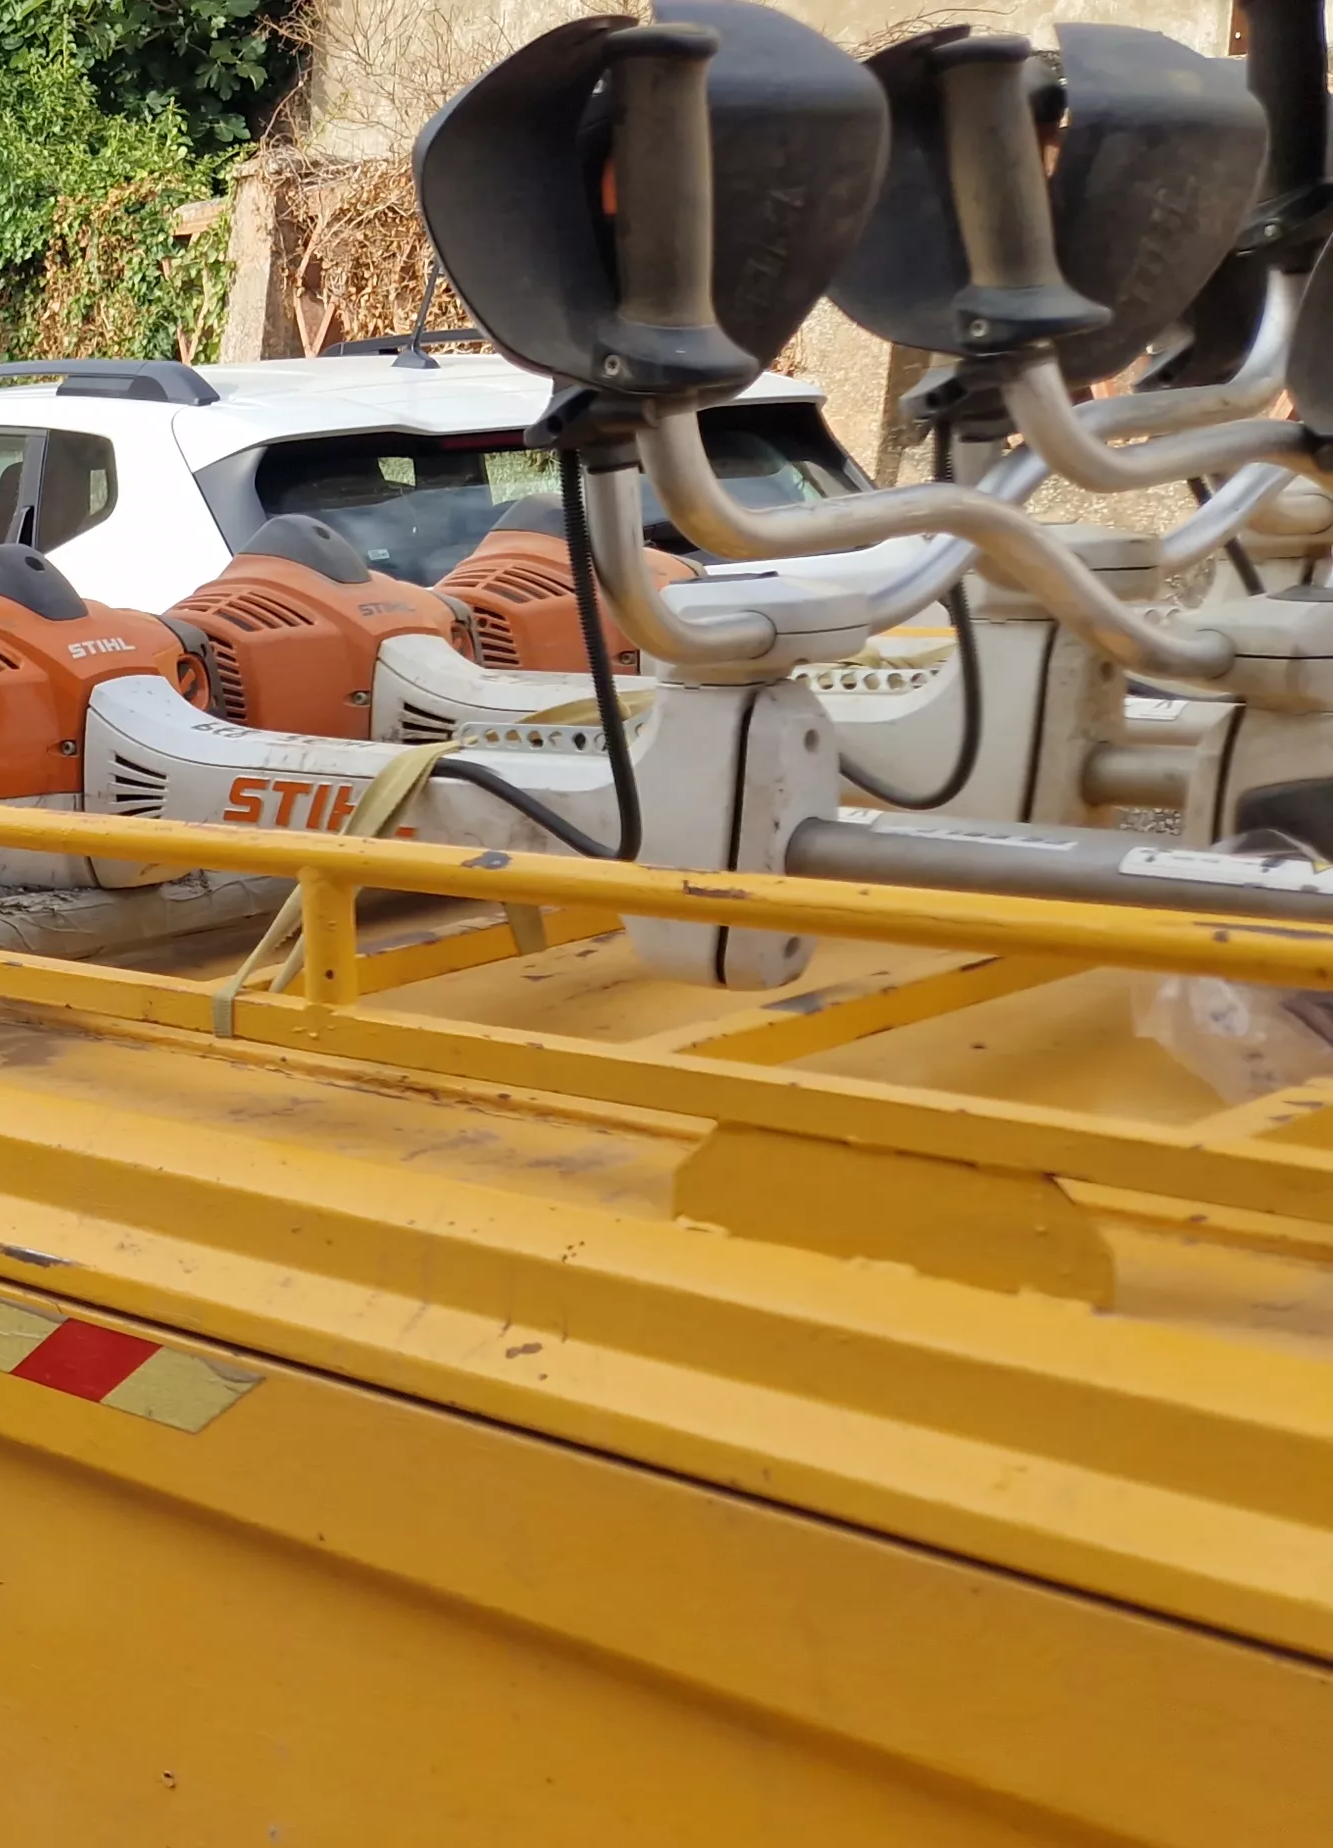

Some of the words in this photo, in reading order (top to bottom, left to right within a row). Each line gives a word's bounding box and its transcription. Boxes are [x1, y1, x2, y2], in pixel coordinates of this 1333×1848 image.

[356, 601, 417, 617] STIHL
[67, 636, 136, 659] STIHL
[223, 776, 416, 838] STIH
